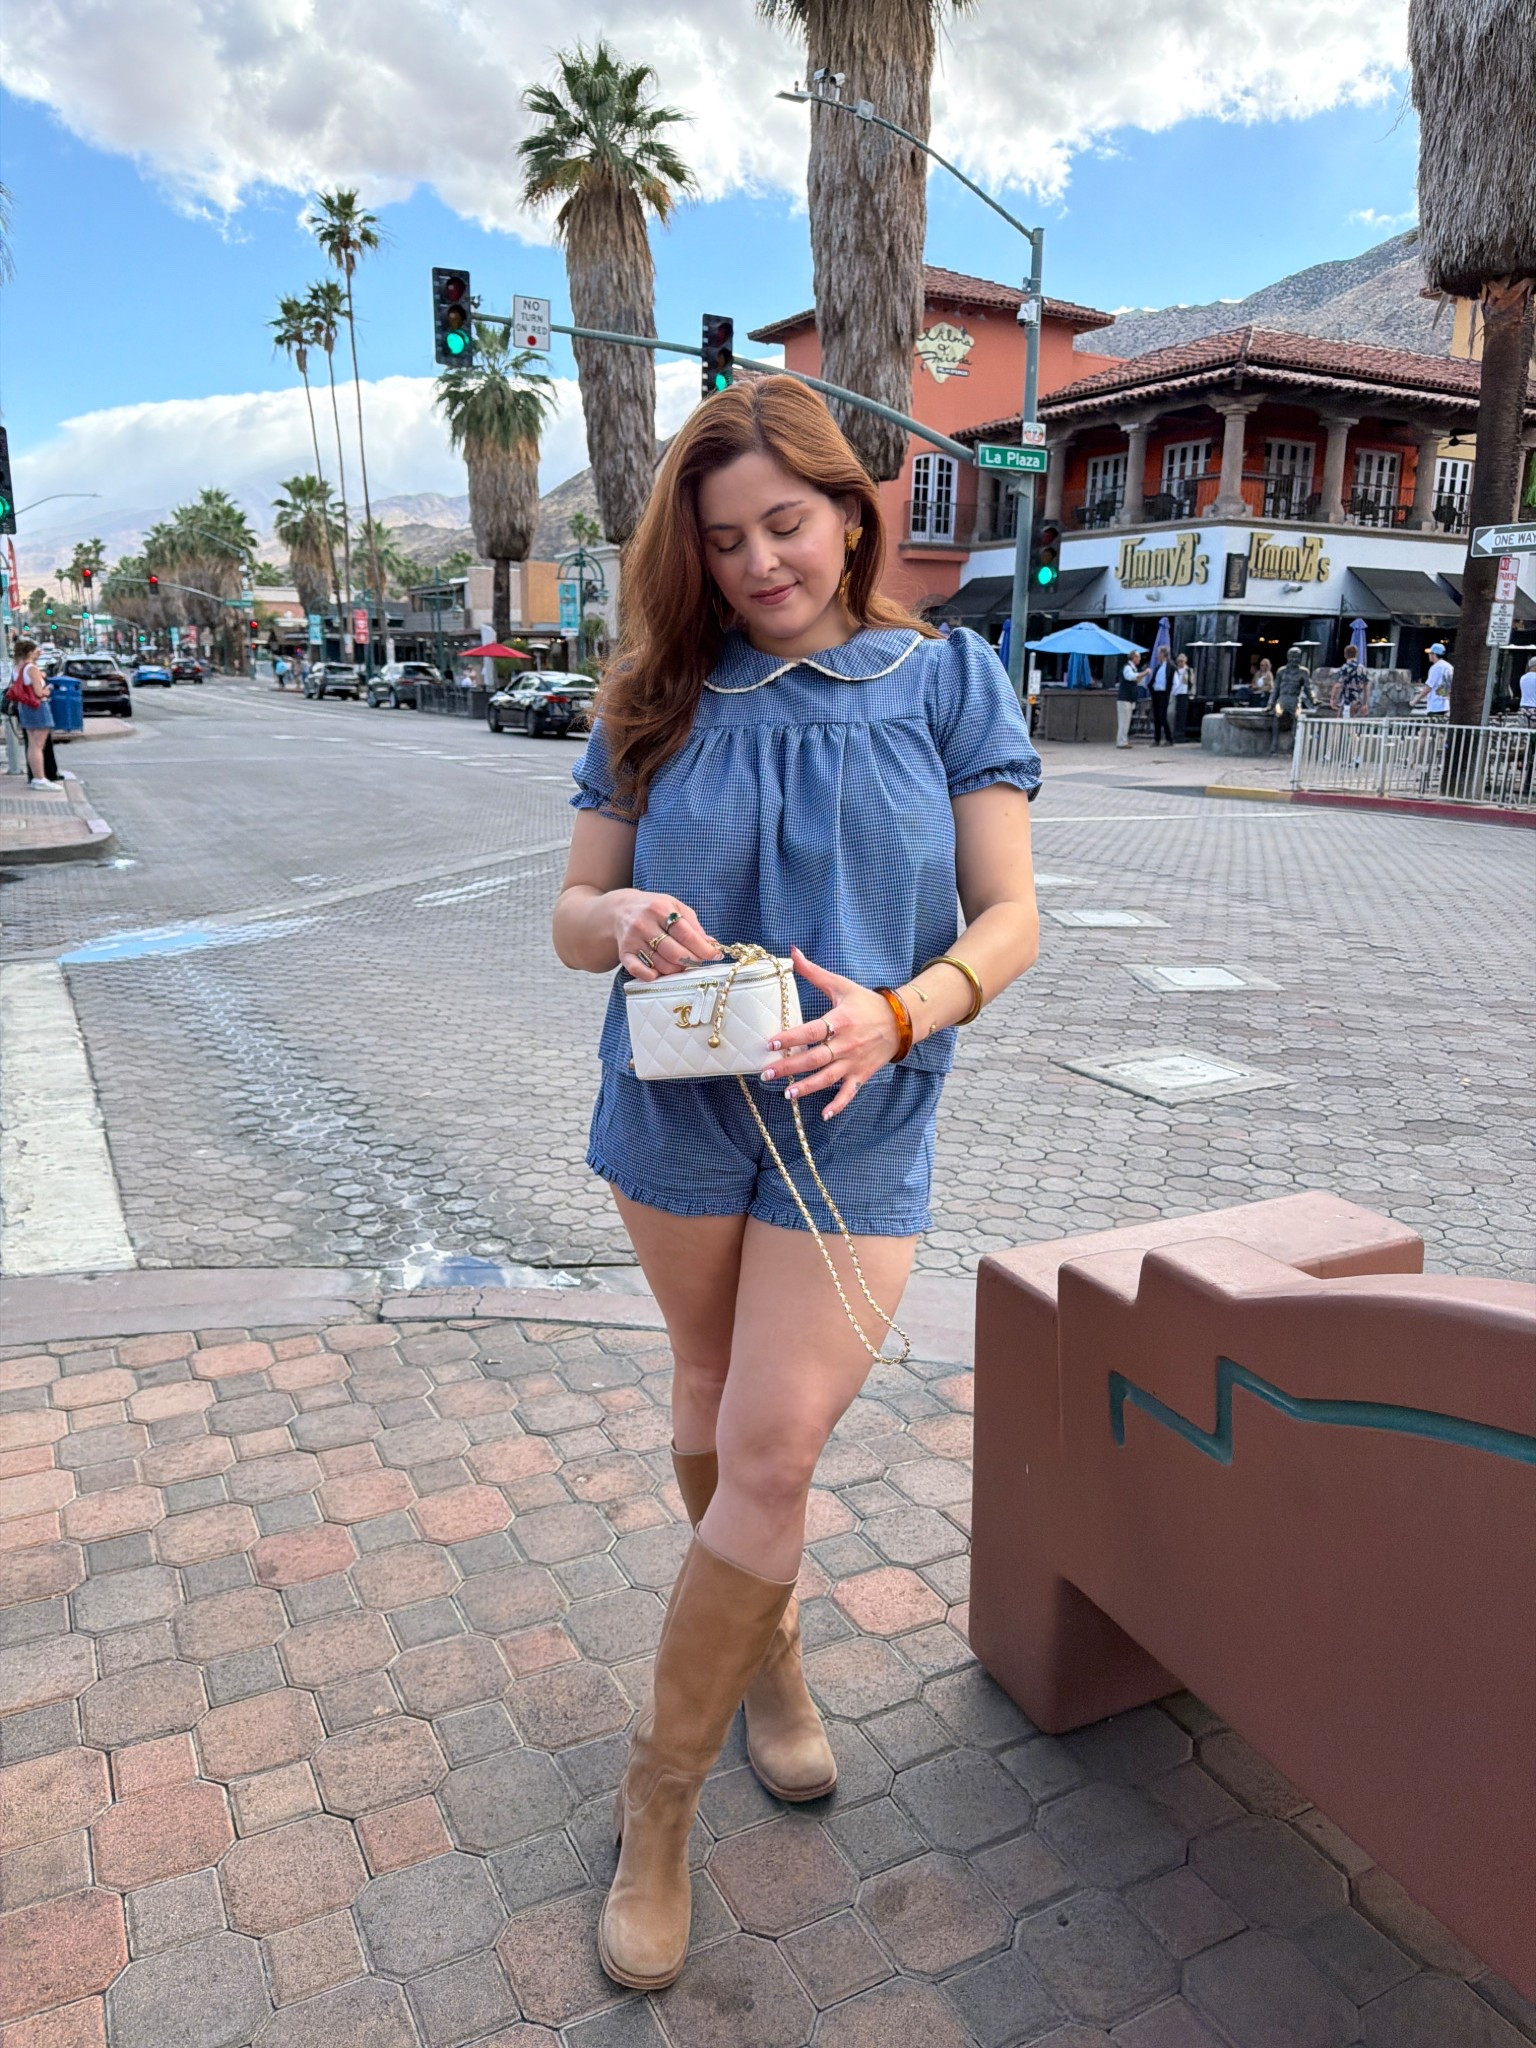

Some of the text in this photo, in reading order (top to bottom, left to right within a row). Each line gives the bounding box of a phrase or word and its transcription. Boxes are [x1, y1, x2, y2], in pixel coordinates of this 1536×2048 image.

[523, 299, 540, 311] NO
[521, 312, 543, 323] TURN
[516, 323, 547, 335] ON RED
[985, 450, 1040, 468] La Plaza
[1495, 531, 1536, 546] ONE WAY
